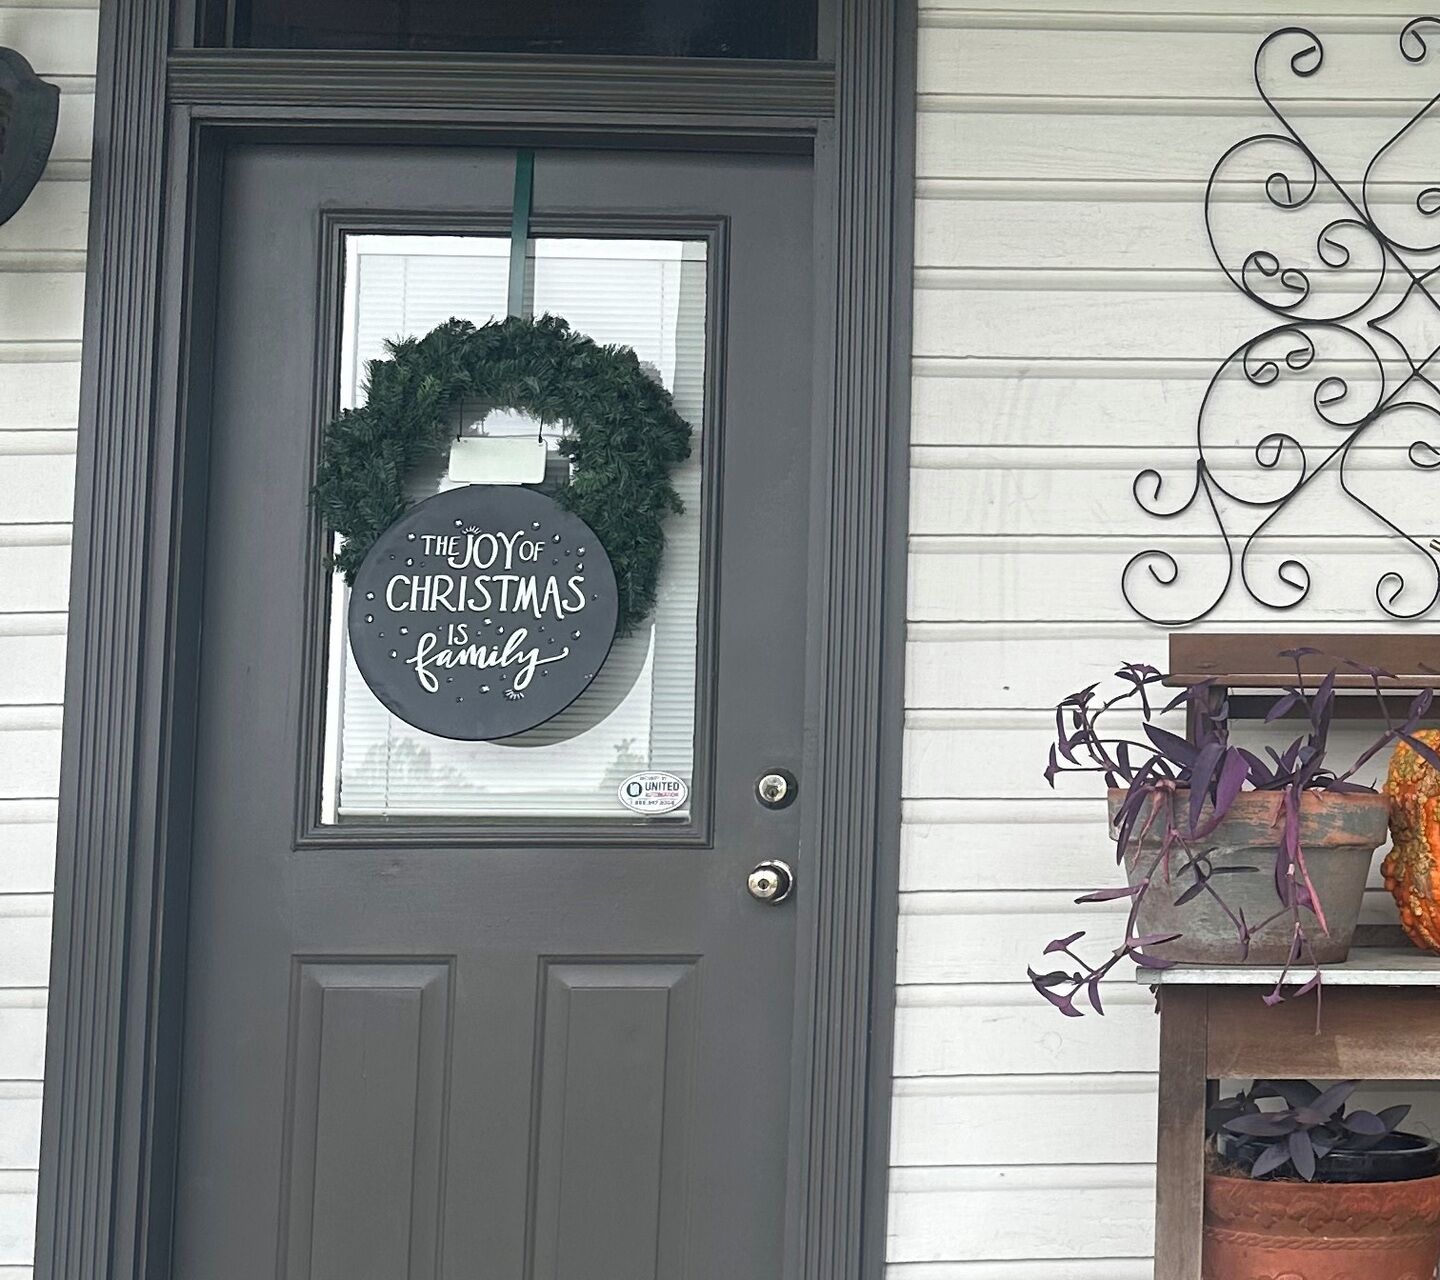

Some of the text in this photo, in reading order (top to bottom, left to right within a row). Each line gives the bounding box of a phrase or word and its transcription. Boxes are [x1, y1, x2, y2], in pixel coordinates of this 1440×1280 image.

[420, 530, 546, 570] THE JOY OF
[385, 574, 586, 619] CHRISTMAS
[447, 623, 469, 646] IS
[406, 628, 570, 693] family
[644, 781, 680, 791] UNITED
